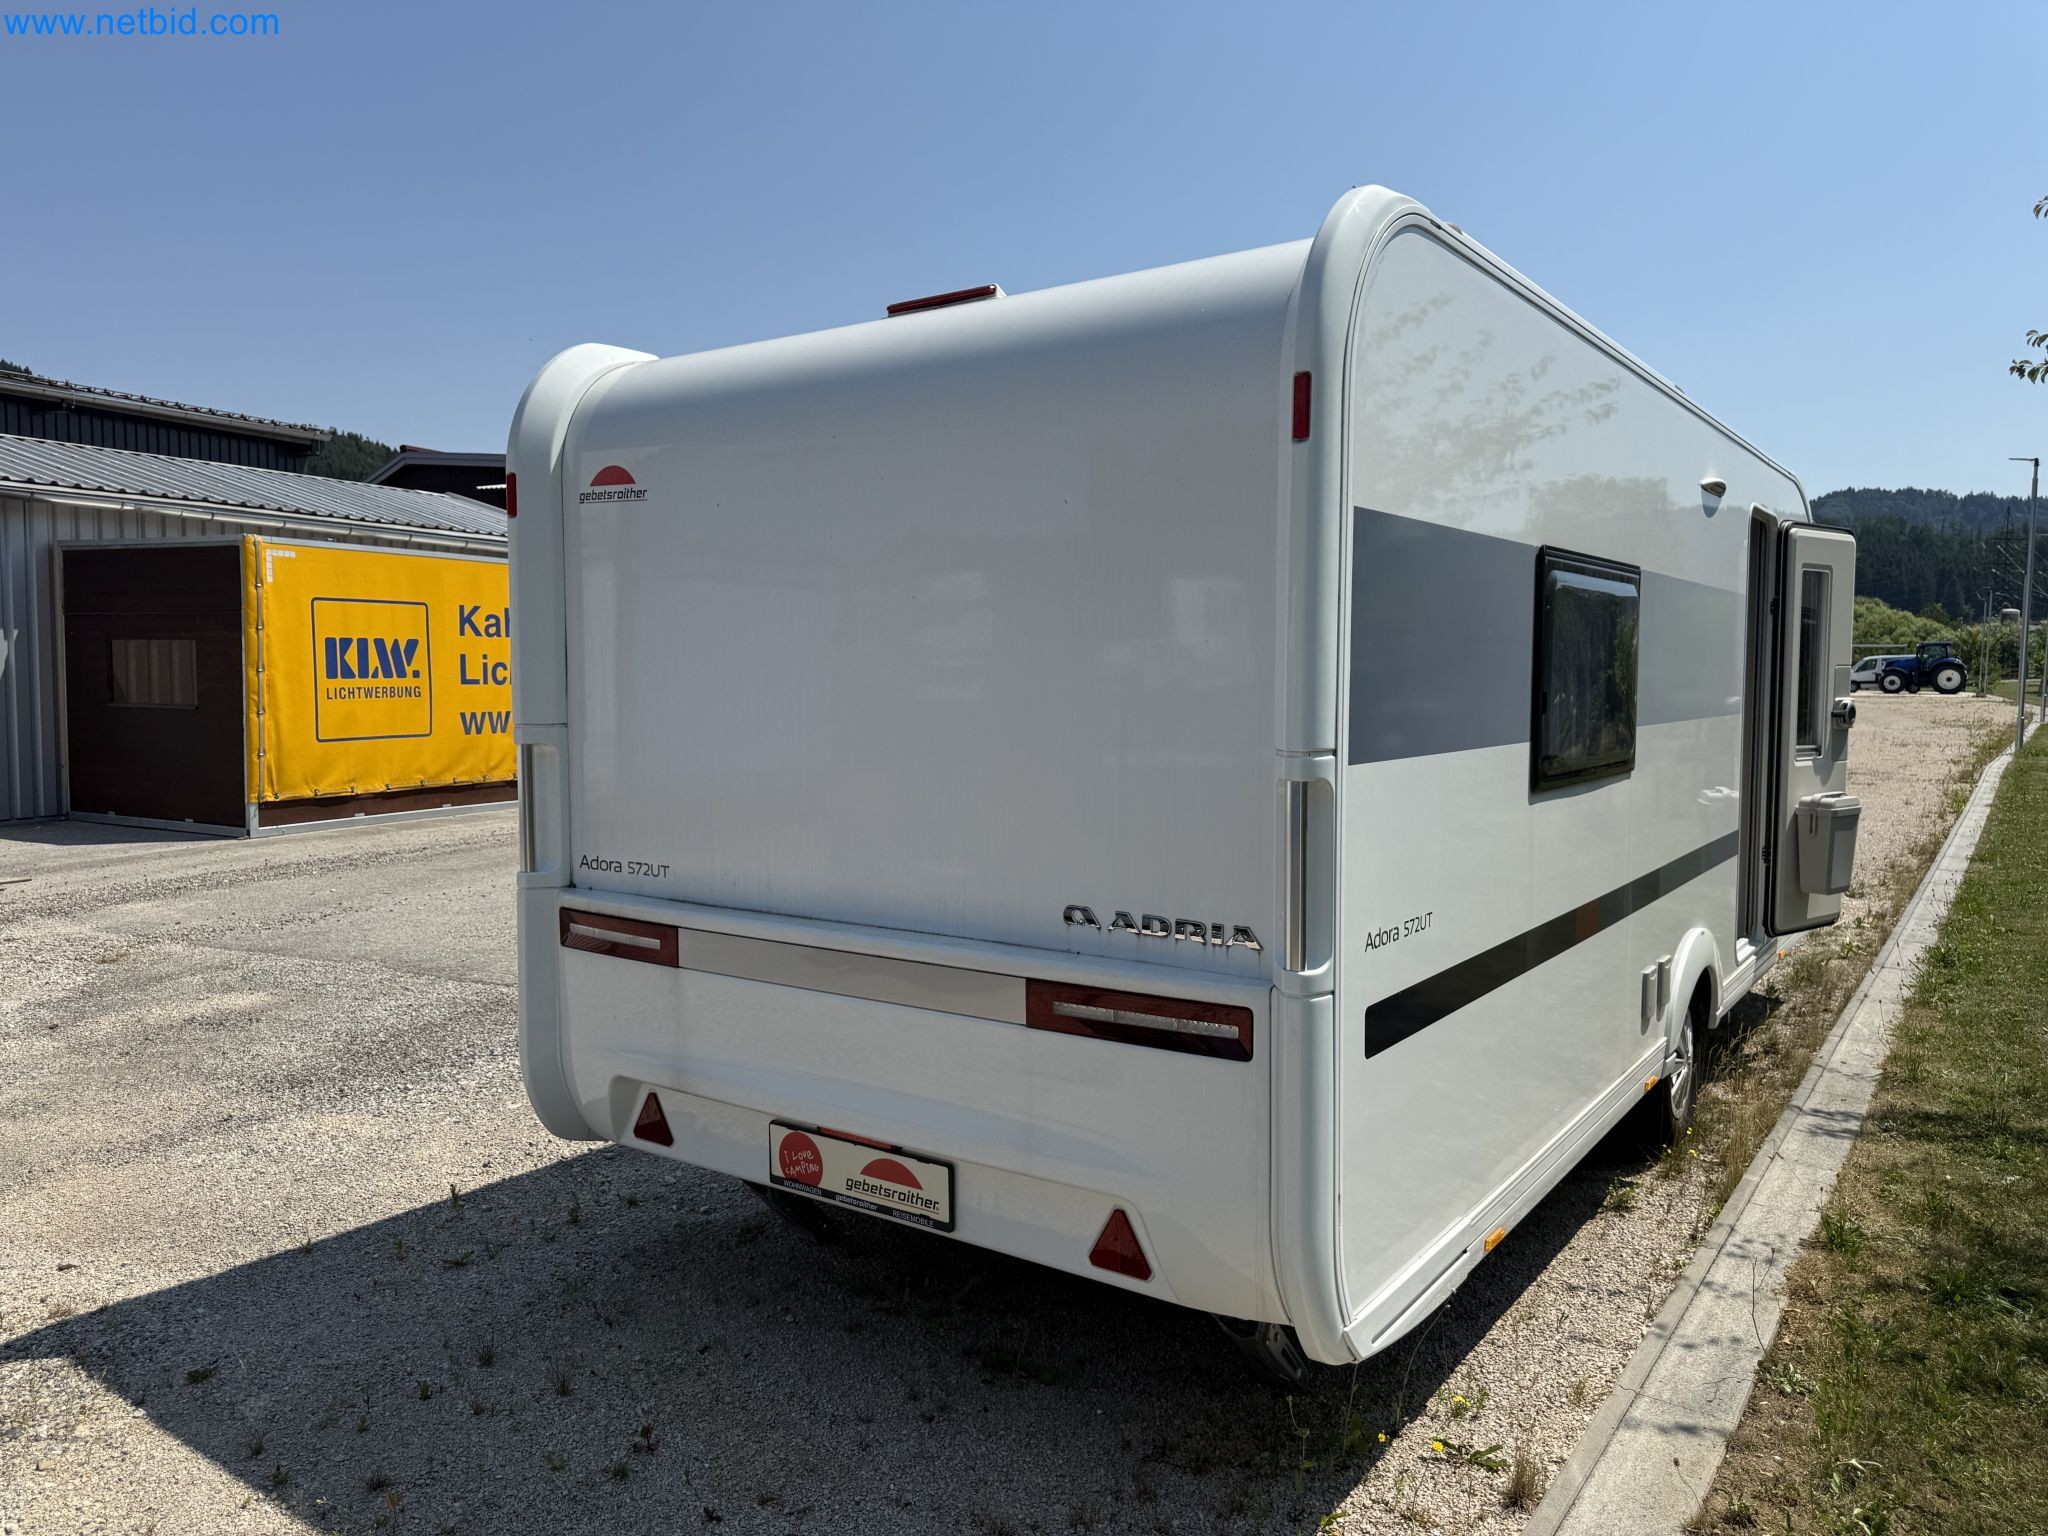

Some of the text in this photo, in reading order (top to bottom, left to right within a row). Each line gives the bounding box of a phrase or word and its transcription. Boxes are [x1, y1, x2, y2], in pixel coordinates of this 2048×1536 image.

[579, 487, 648, 504] gebetsroither
[460, 653, 512, 686] Lic
[326, 685, 422, 700] LICHTWERBUNG
[579, 854, 670, 878] Adora 572UT
[1107, 910, 1264, 951] ADRIA
[1364, 911, 1433, 953] Adora 572UT
[783, 1179, 823, 1197] WOHNWAGEN
[892, 1209, 935, 1228] REISEMOBILE
[845, 1177, 940, 1211] gebetsroither
